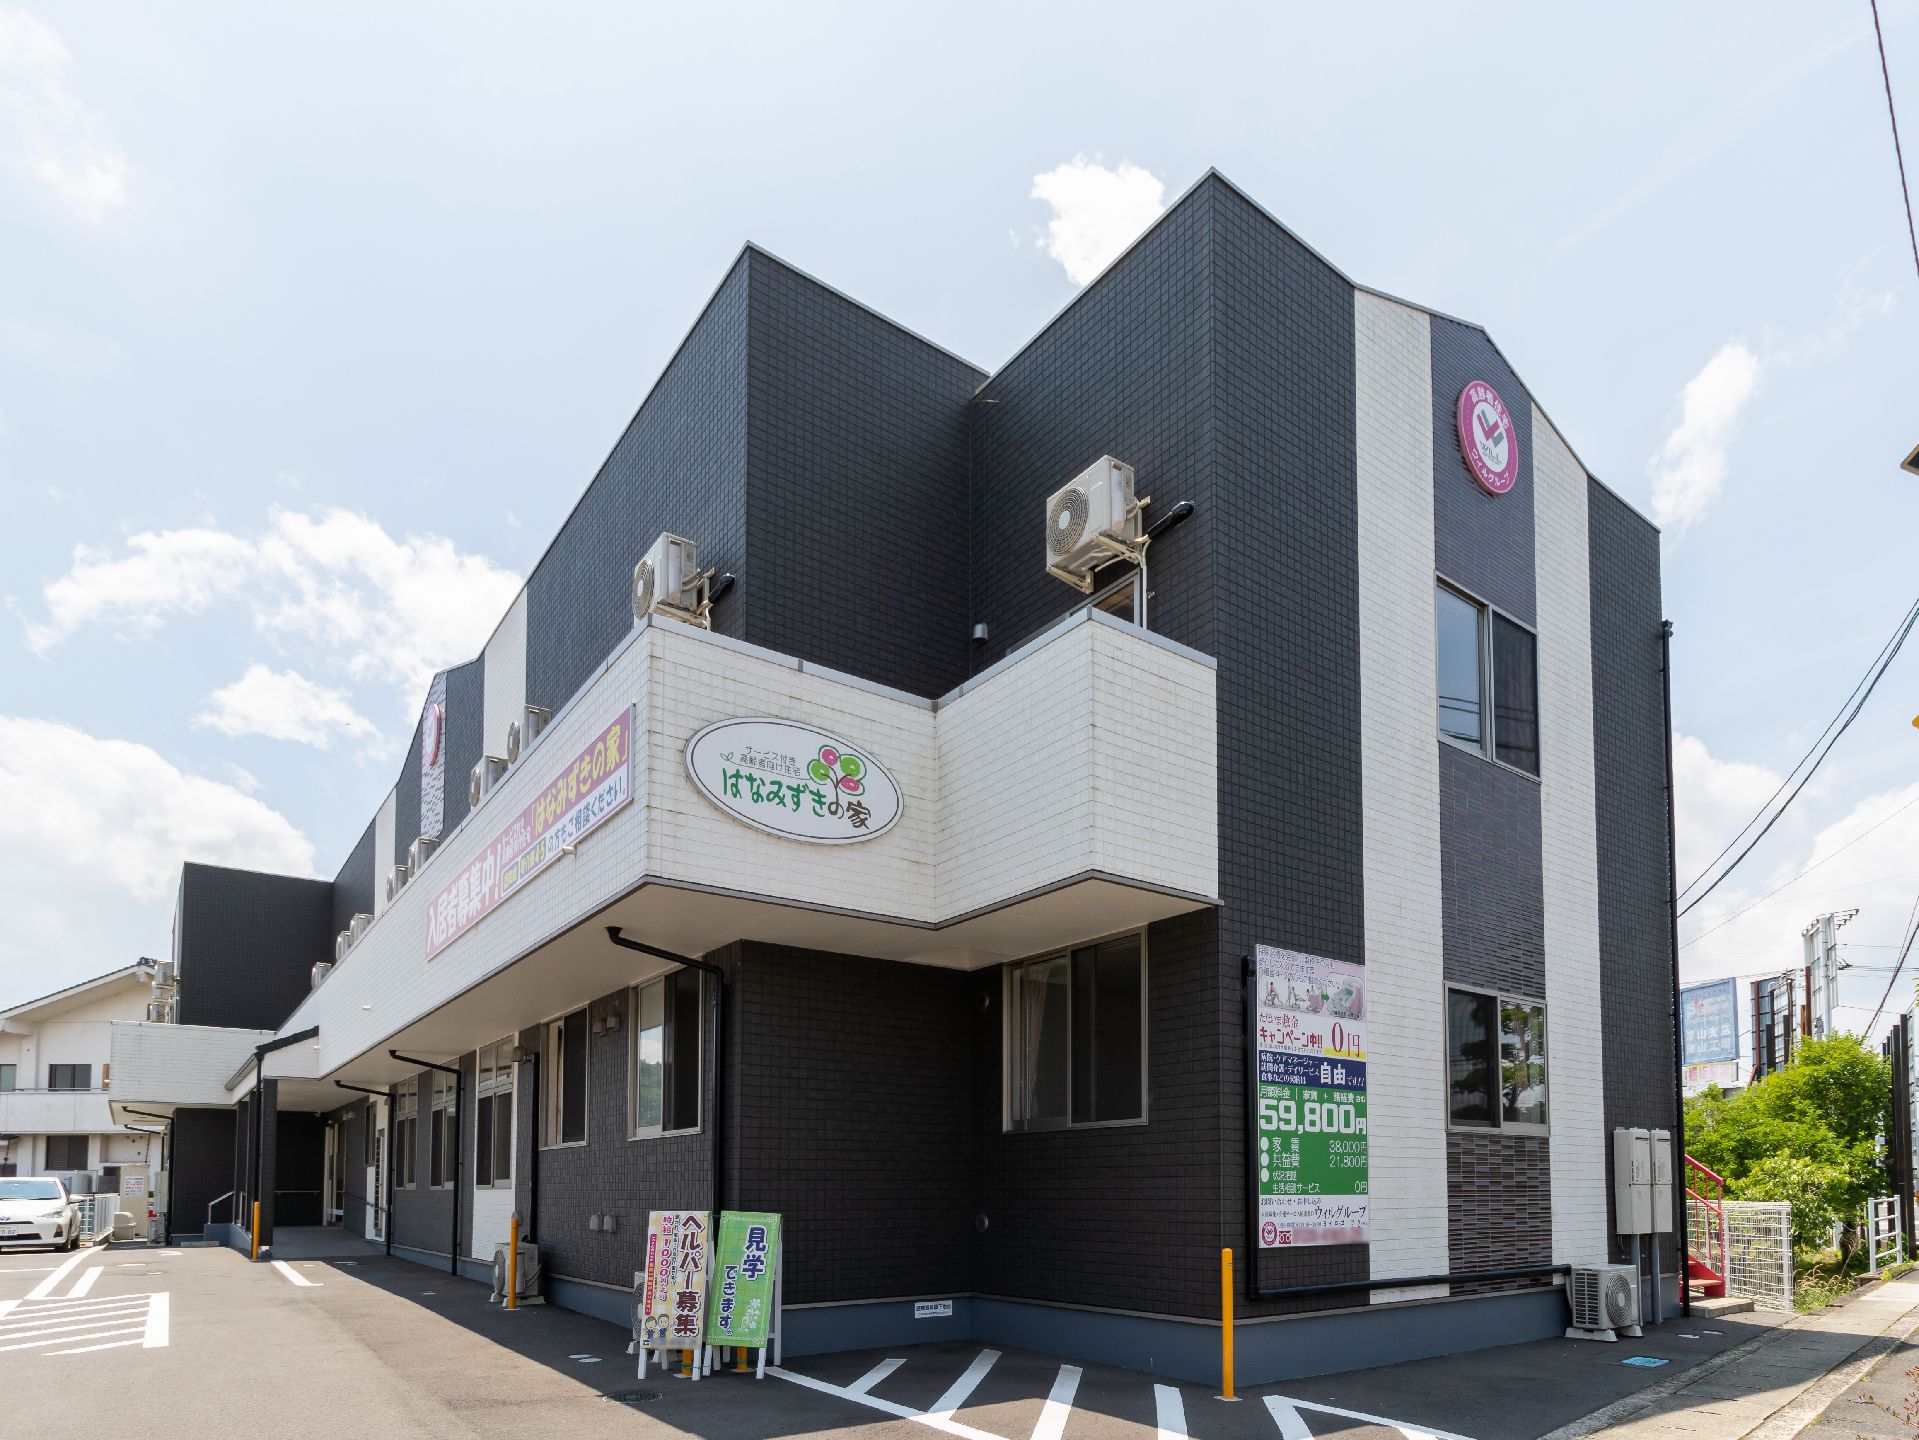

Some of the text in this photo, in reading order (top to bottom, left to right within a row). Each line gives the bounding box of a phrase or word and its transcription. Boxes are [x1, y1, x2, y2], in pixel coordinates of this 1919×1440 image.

[740, 753, 804, 777] 高齢者向け住宅
[745, 746, 796, 766] サービス付き
[722, 767, 872, 830] はなみずきの家
[1260, 1099, 1367, 1135] 59,800円
[1329, 1140, 1367, 1153] 38,000円
[1272, 1152, 1367, 1168] 共益費 21,800円
[1272, 1181, 1368, 1194] 生活相談サービス 0円
[1315, 1204, 1368, 1219] ウィルグループ
[742, 1226, 766, 1279] 見学
[674, 1215, 703, 1335] ヘルパー募集
